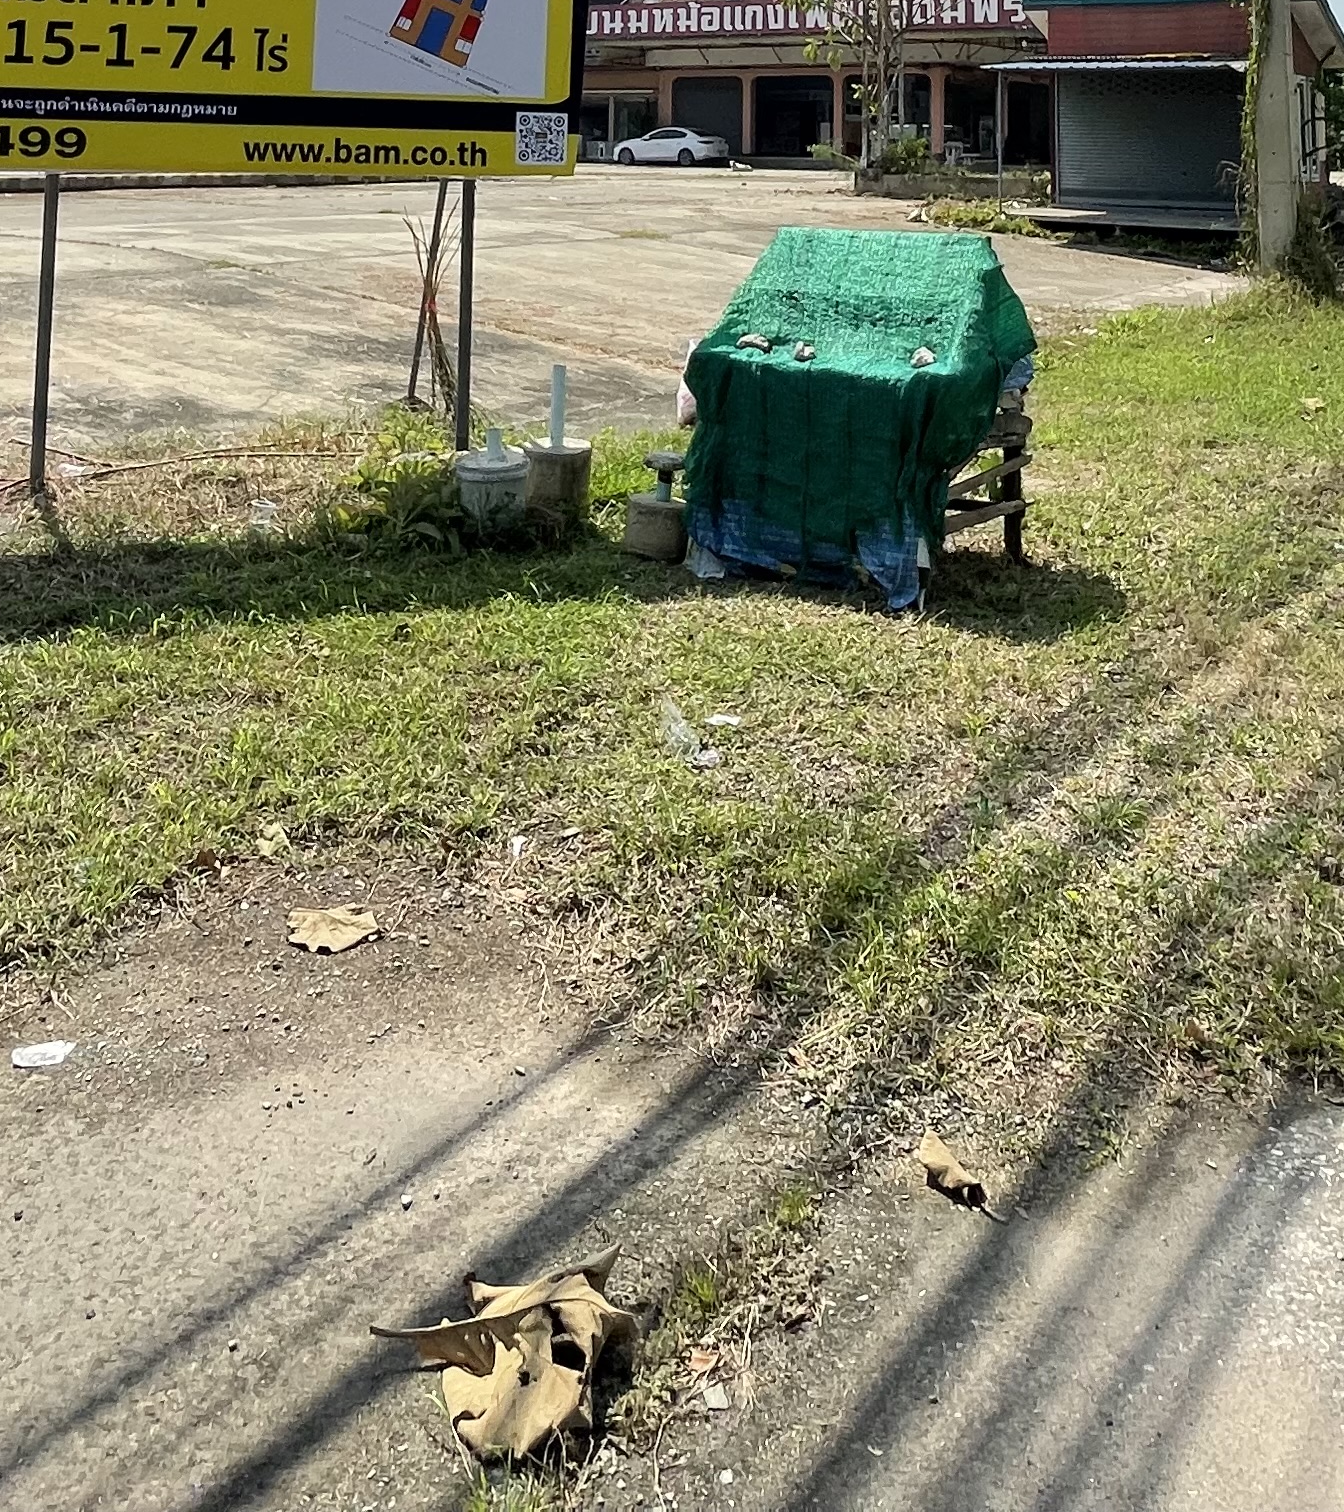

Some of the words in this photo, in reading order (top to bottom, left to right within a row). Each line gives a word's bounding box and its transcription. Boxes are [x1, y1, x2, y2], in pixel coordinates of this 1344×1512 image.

[3, 17, 236, 72] 15-1-74
[256, 28, 289, 74] ไร่
[242, 137, 488, 169] www.bam.co.th
